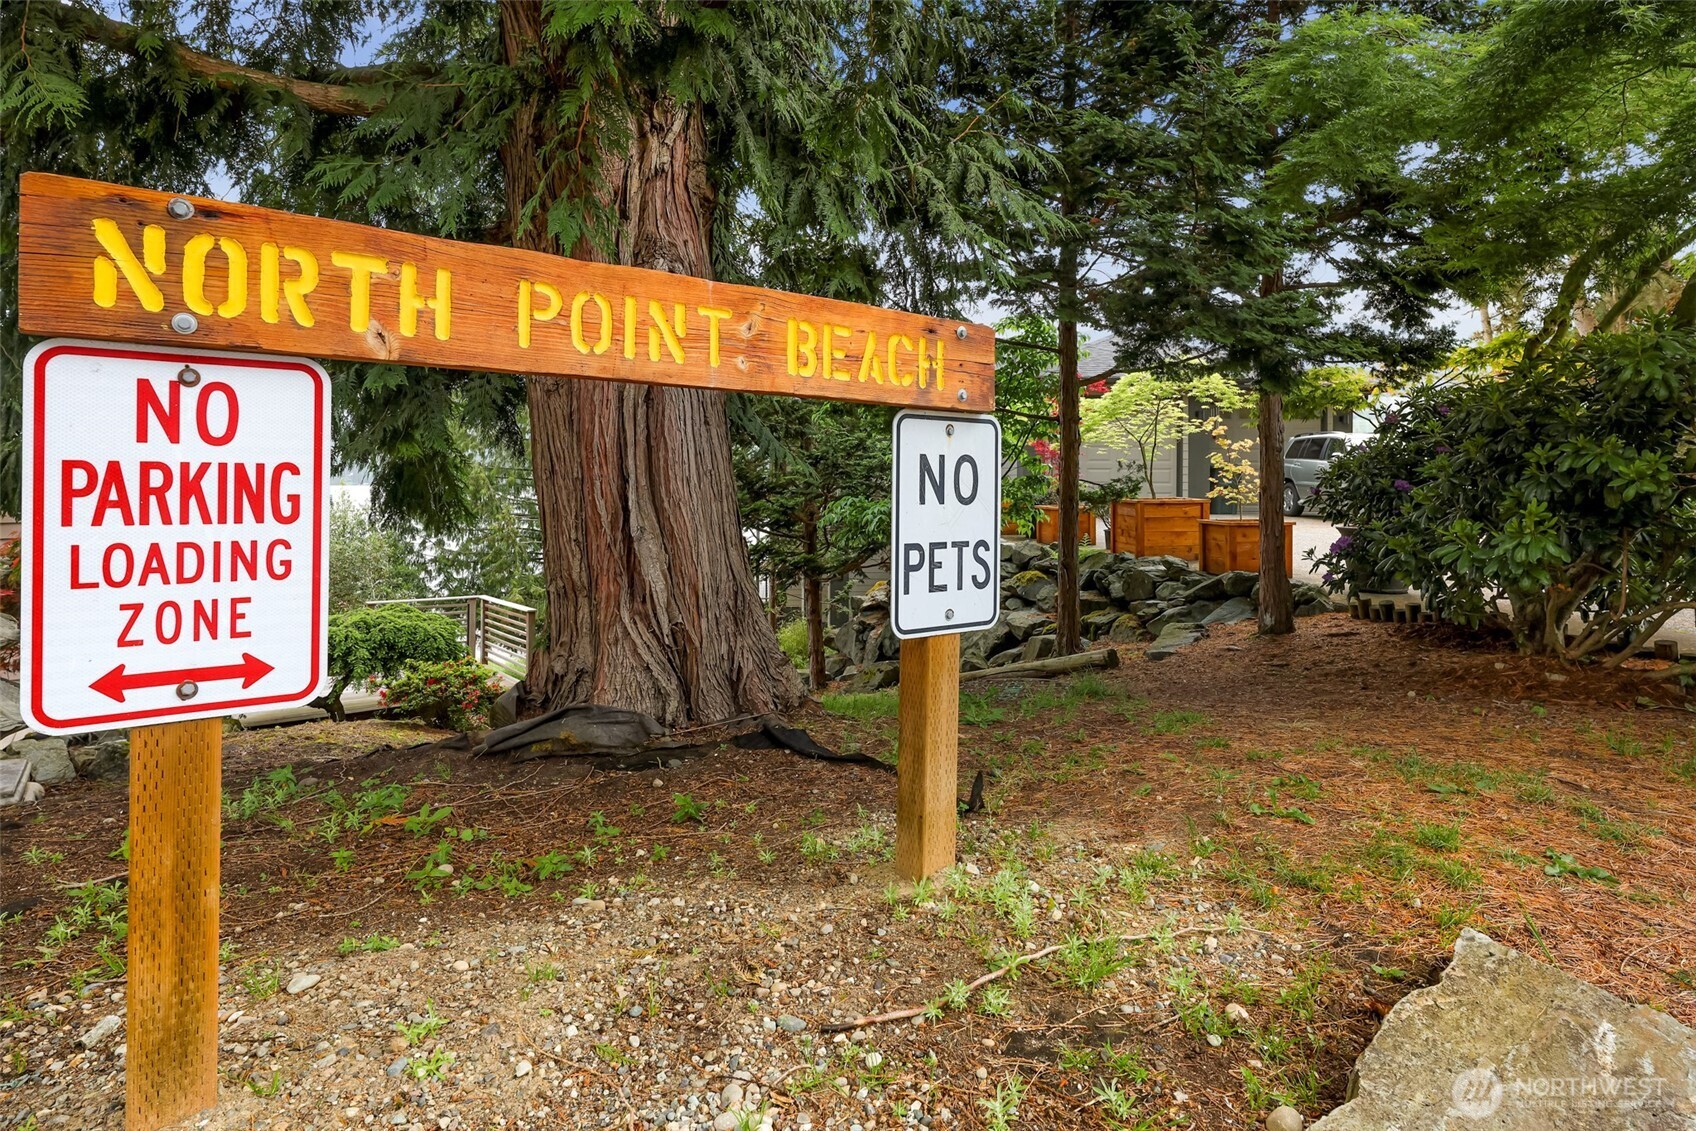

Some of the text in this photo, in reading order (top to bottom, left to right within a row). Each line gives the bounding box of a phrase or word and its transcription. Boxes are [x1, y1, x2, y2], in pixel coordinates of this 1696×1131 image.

[92, 218, 945, 391] NORTH POINT BEACH
[136, 378, 239, 446] NO
[61, 460, 300, 527] PARKING
[919, 453, 979, 506] NO
[70, 539, 292, 590] LOADING
[903, 540, 991, 595] PETS
[117, 597, 252, 648] ZONE
